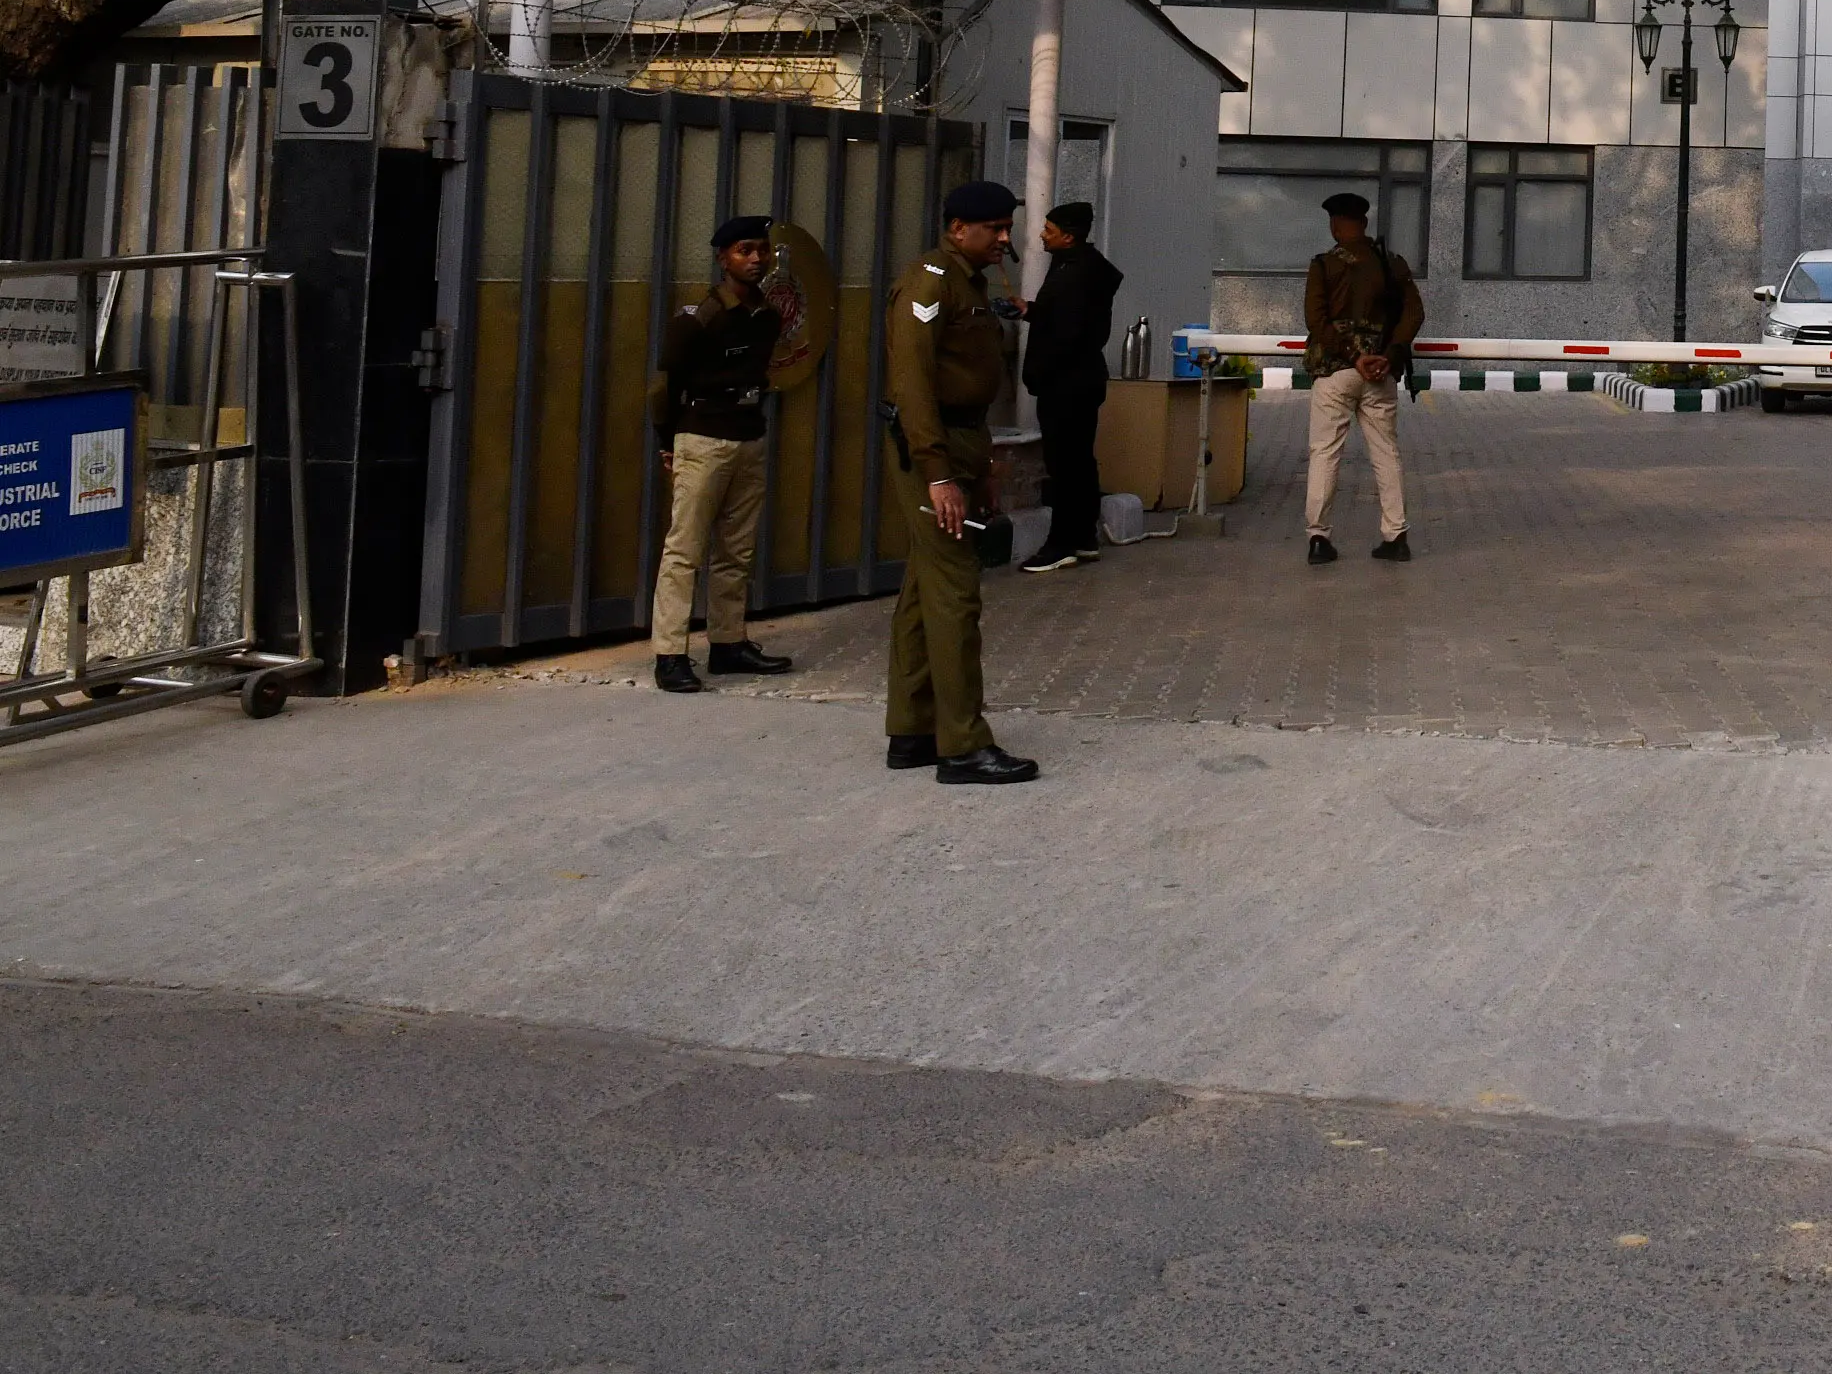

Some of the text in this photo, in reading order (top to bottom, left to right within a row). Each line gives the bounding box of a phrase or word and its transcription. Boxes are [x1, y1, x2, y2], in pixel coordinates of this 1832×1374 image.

[292, 26, 369, 38] GATE NO.
[299, 42, 354, 128] 3
